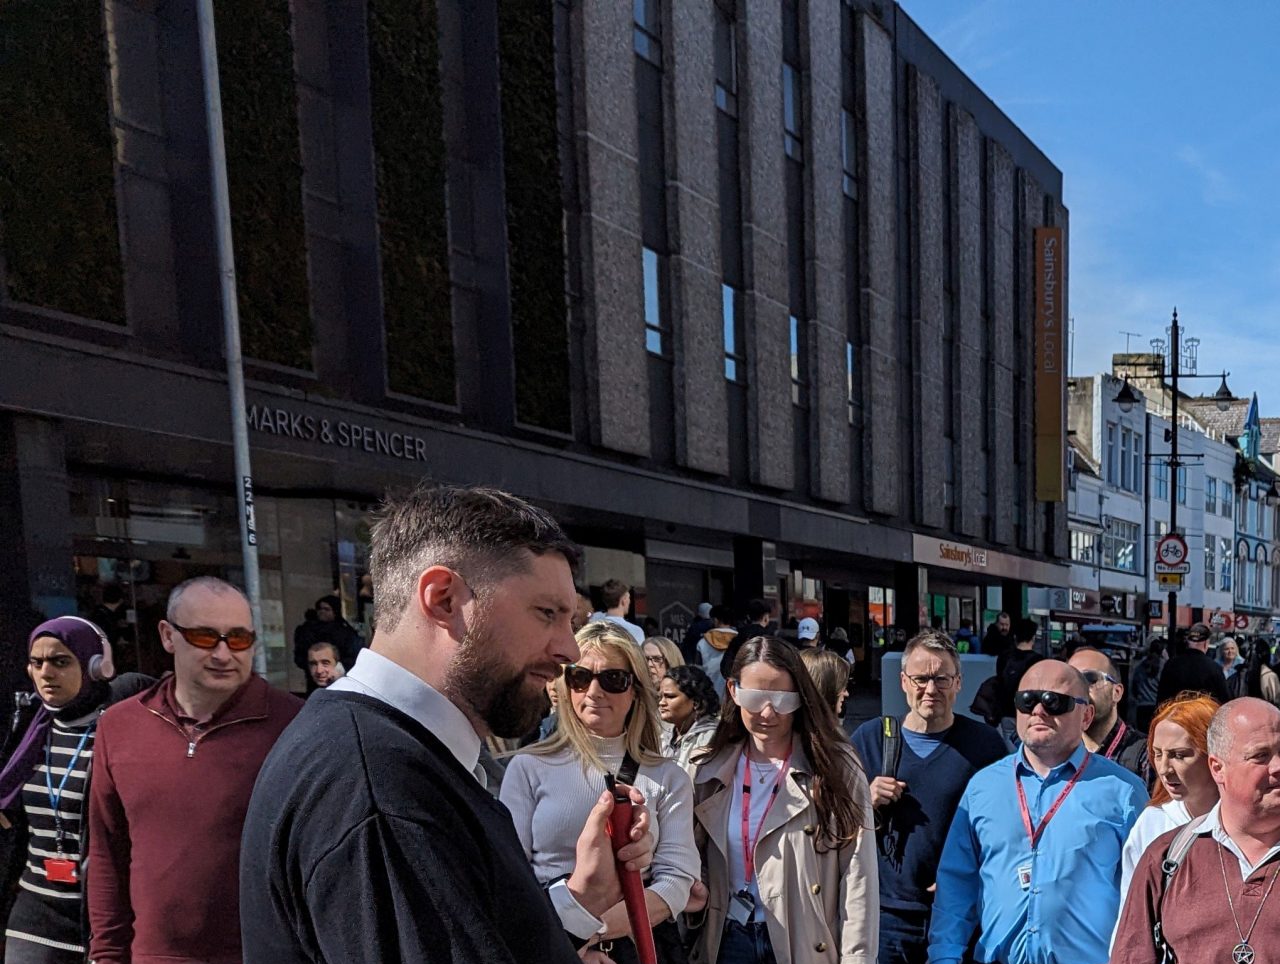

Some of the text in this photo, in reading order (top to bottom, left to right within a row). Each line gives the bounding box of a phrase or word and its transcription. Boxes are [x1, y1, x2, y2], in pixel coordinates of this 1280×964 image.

[246, 404, 428, 461] MARKS & SPENCER
[939, 543, 972, 567] Sainsbury's
